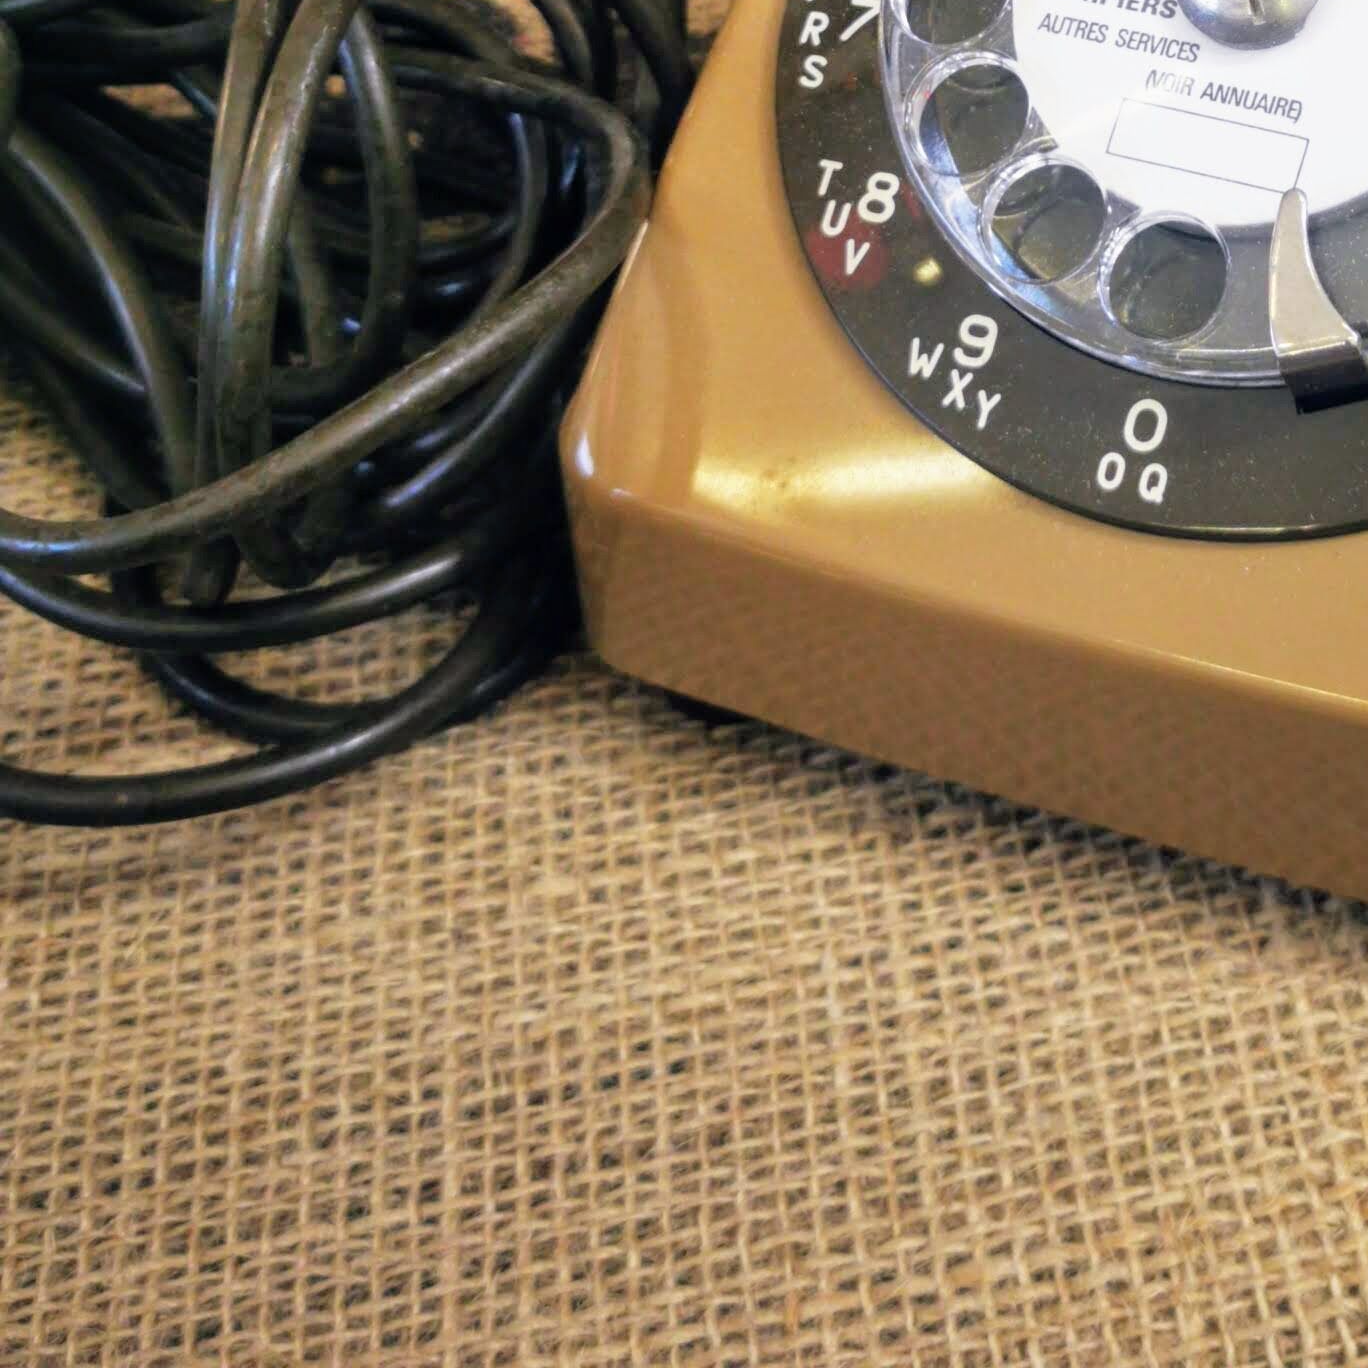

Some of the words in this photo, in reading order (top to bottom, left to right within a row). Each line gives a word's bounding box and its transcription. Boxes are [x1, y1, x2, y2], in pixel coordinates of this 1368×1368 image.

[1036, 12, 1111, 45] AUTRES
[1114, 27, 1201, 65] SERVICES
[1200, 80, 1304, 125] ANNUAIRE)
[856, 170, 900, 225] 8
[952, 313, 999, 369] 9
[907, 336, 1002, 430] WXY
